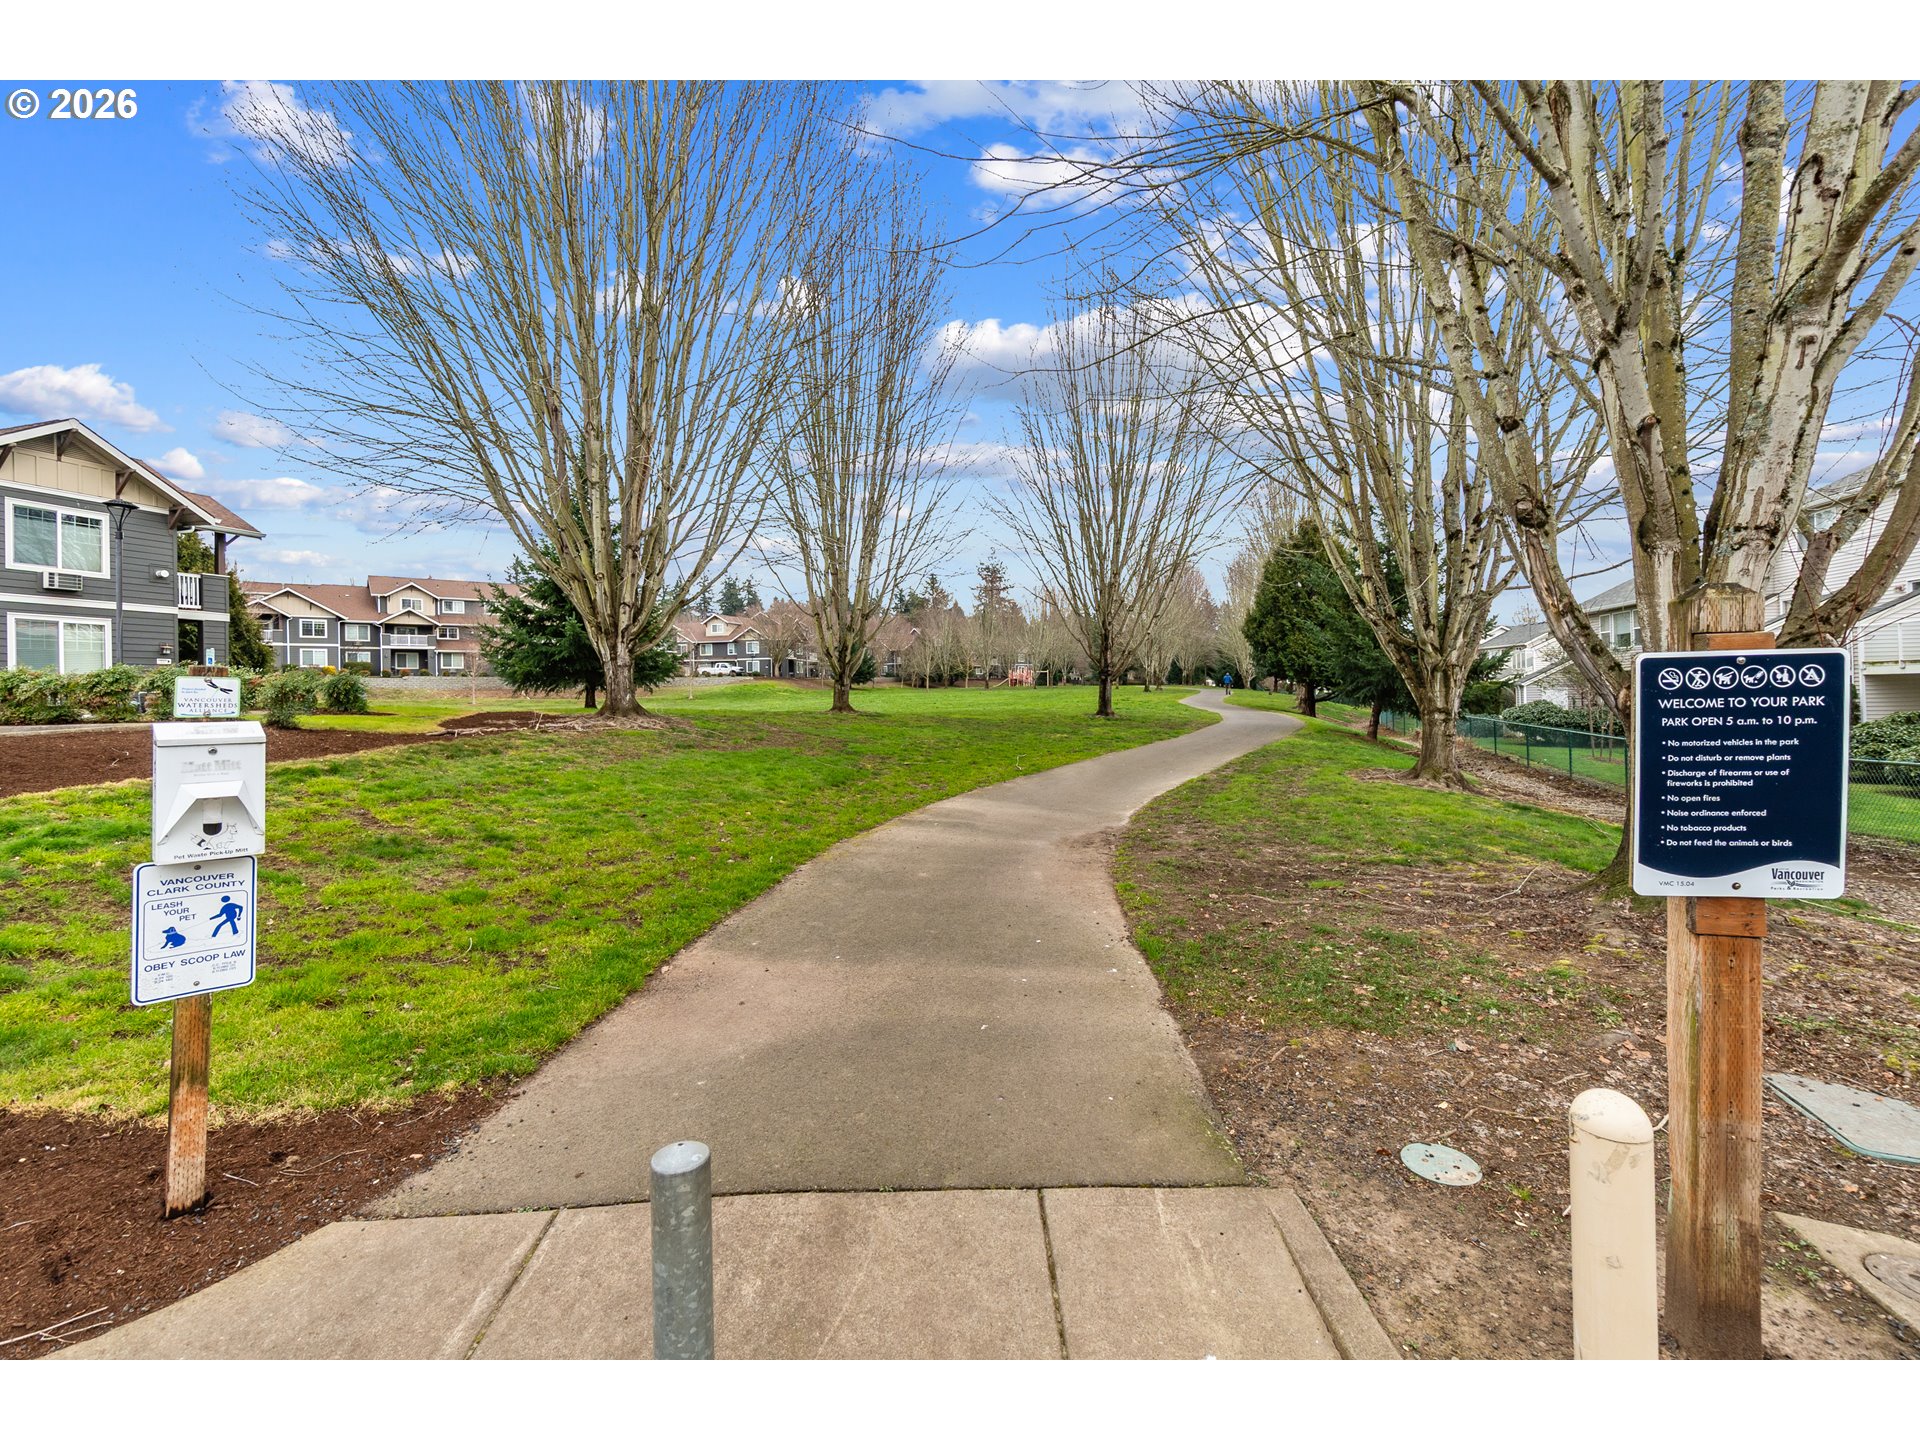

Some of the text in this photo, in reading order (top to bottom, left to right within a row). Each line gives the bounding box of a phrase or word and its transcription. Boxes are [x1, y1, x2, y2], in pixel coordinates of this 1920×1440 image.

[1658, 696, 1825, 709] WELCOME TO YOUR PARK
[1662, 717, 1688, 726] PARK
[1692, 717, 1722, 726] OPEN
[1726, 717, 1733, 725] 5
[1762, 717, 1773, 725] to
[1777, 716, 1790, 724] 10
[1795, 717, 1817, 726] p.m.
[1779, 738, 1799, 746] park
[1767, 754, 1791, 762] plants
[1712, 780, 1753, 788] prohibited
[1772, 868, 1824, 880] Vancouver
[160, 873, 234, 886] VANCOUVER
[147, 880, 245, 896] CLARK COUNTY
[152, 901, 183, 910] LEASH
[163, 908, 189, 916] YOUR
[144, 950, 246, 972] OBEY SCOOP LAW
